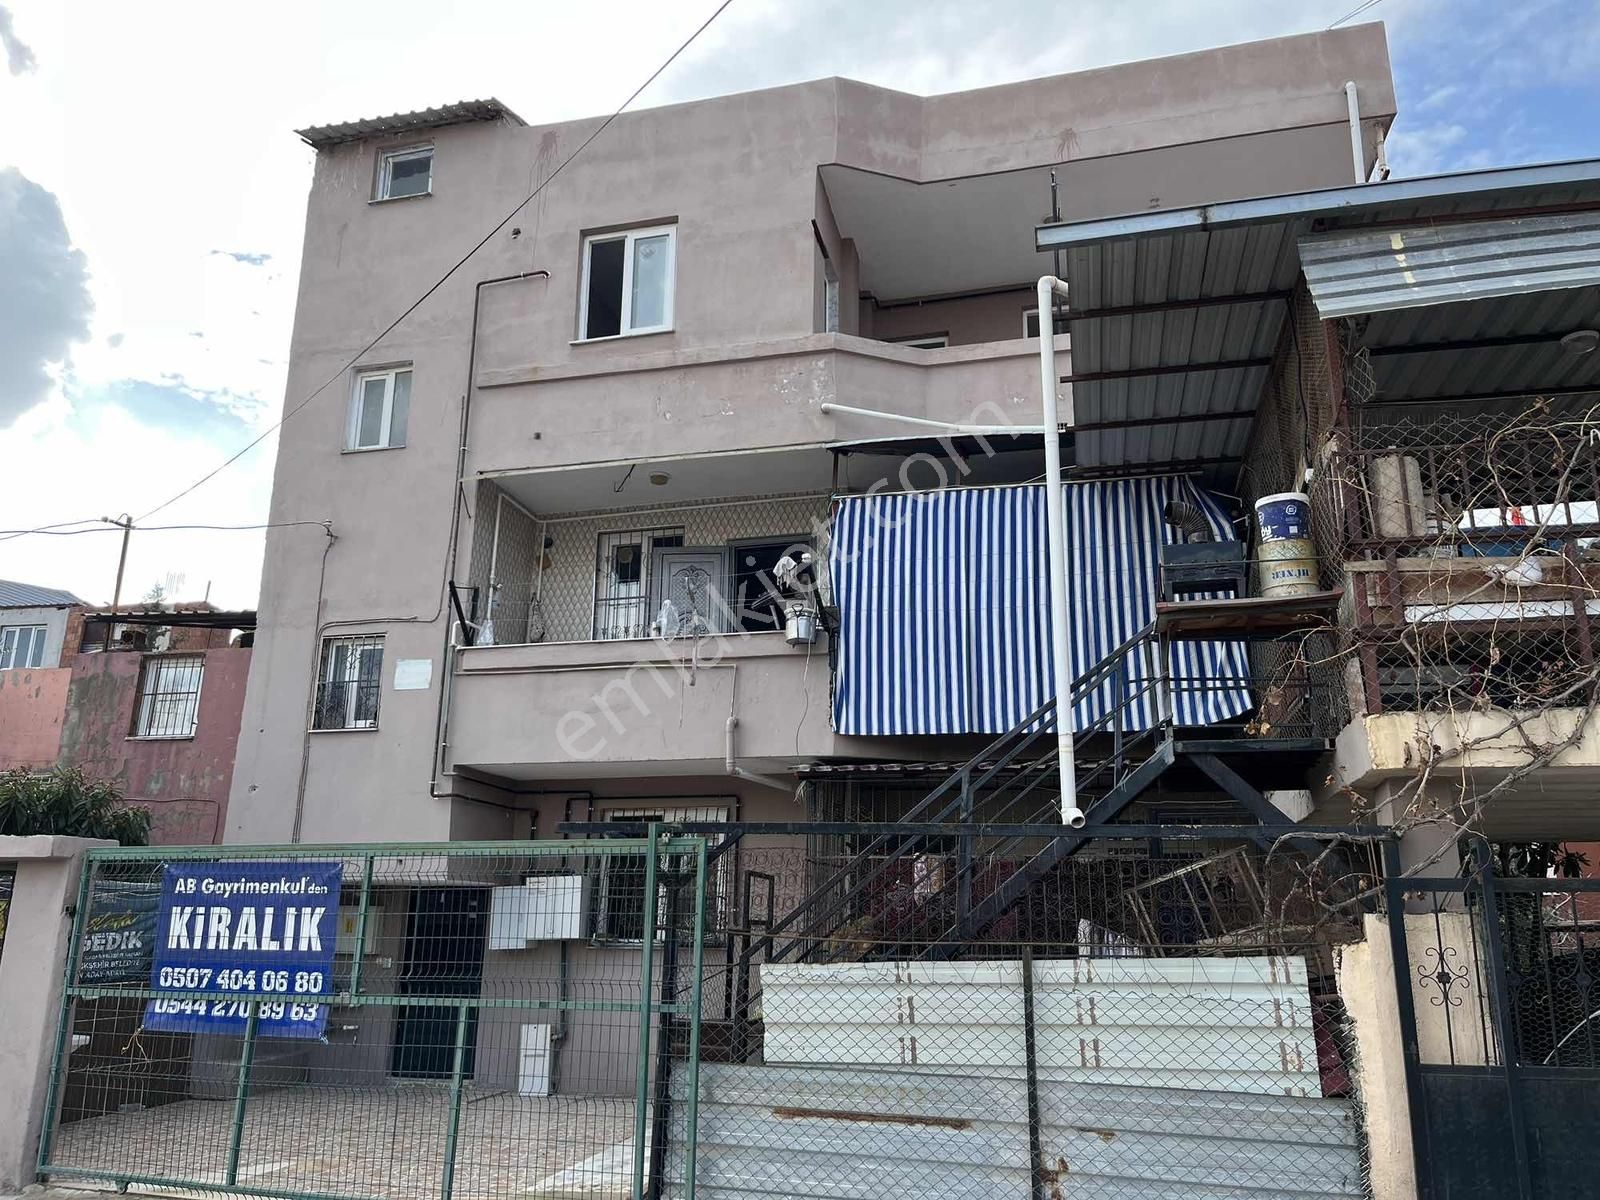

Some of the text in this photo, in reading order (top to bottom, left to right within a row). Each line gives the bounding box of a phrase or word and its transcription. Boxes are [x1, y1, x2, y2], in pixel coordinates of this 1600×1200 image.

[174, 878, 197, 895] AB
[159, 966, 324, 994] 0507 404 06 80
[154, 1000, 320, 1022] 0544 270 89 63
